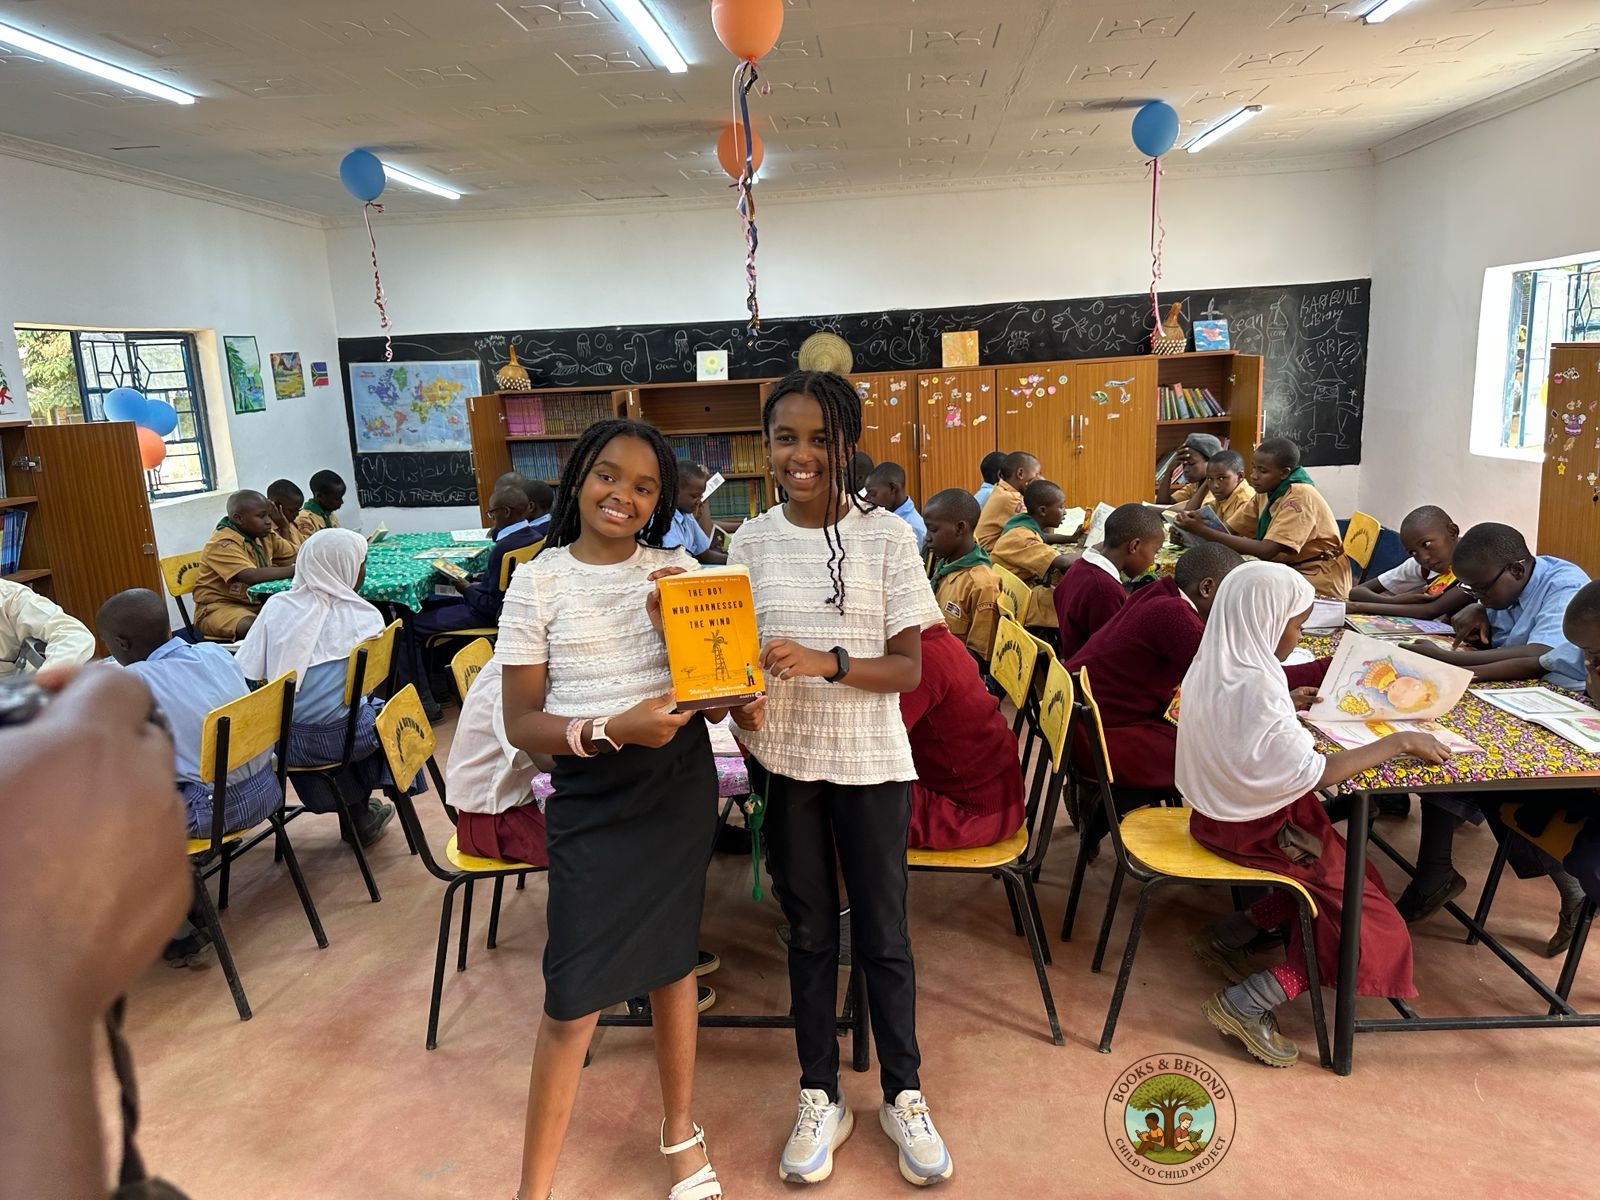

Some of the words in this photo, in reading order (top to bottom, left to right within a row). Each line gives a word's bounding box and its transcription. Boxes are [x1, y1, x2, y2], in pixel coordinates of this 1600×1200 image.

[360, 489, 381, 504] THIS
[385, 489, 394, 502] IS
[399, 490, 406, 503] A
[687, 588, 703, 597] THE
[707, 586, 723, 596] BOY
[671, 605, 690, 615] WHO
[694, 600, 744, 612] HARNESSED
[689, 620, 705, 629] THE
[708, 616, 731, 627] WIND
